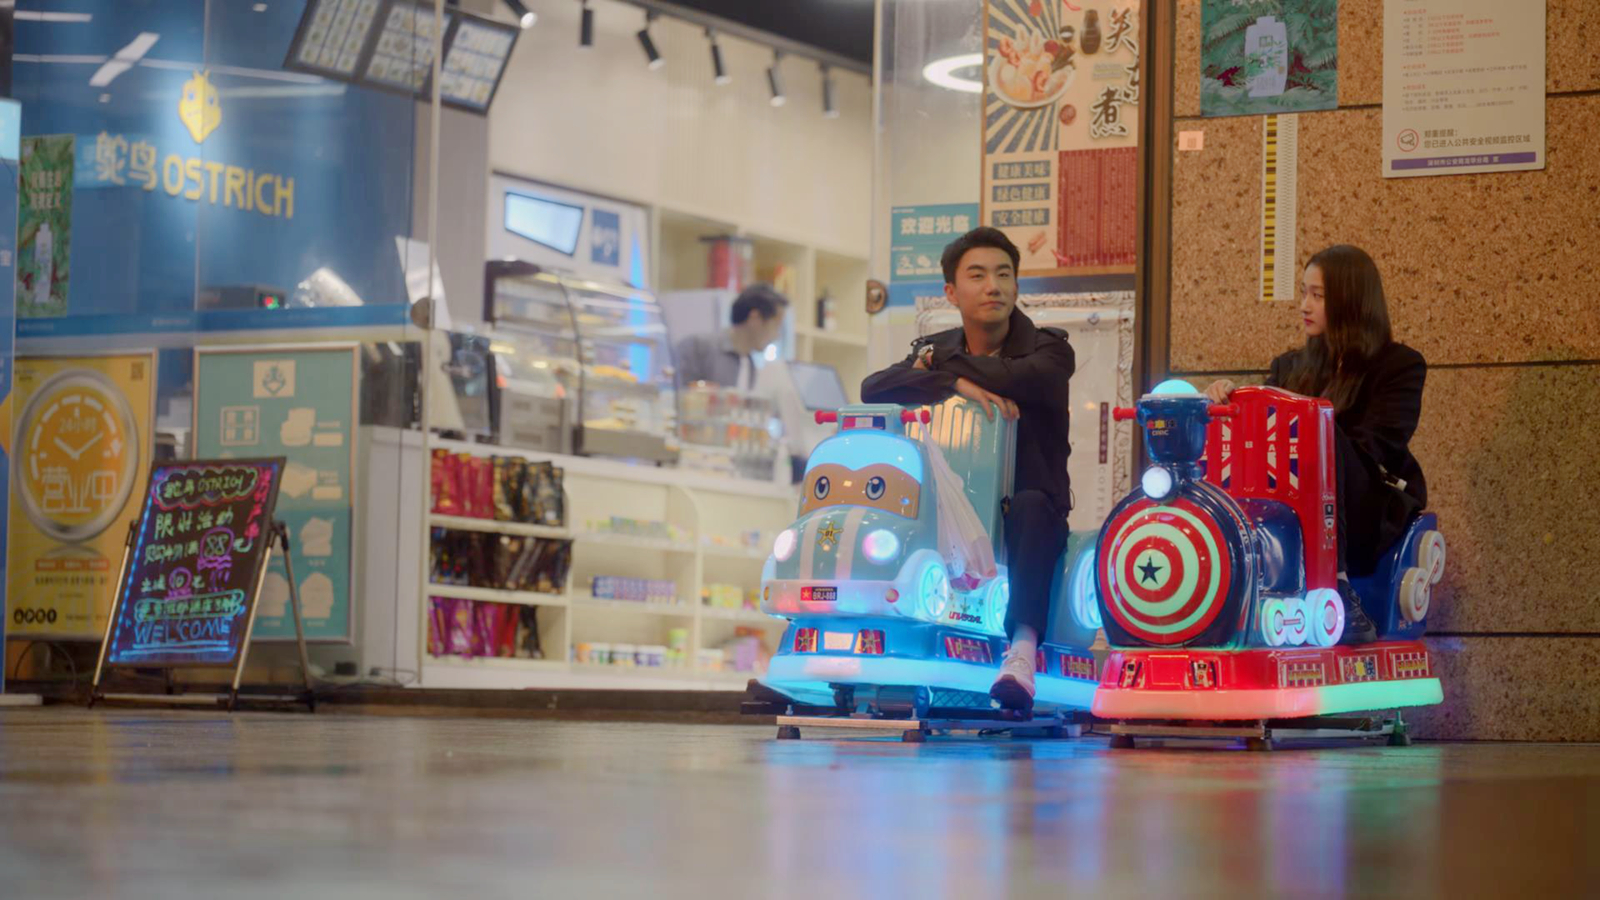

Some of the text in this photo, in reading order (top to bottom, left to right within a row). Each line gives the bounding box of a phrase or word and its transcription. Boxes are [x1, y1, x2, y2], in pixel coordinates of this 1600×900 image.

[95, 130, 157, 191] 鸵鸟
[162, 154, 295, 219] OSTRICH
[42, 466, 117, 514] 营业中
[133, 615, 231, 645] WELCOME
